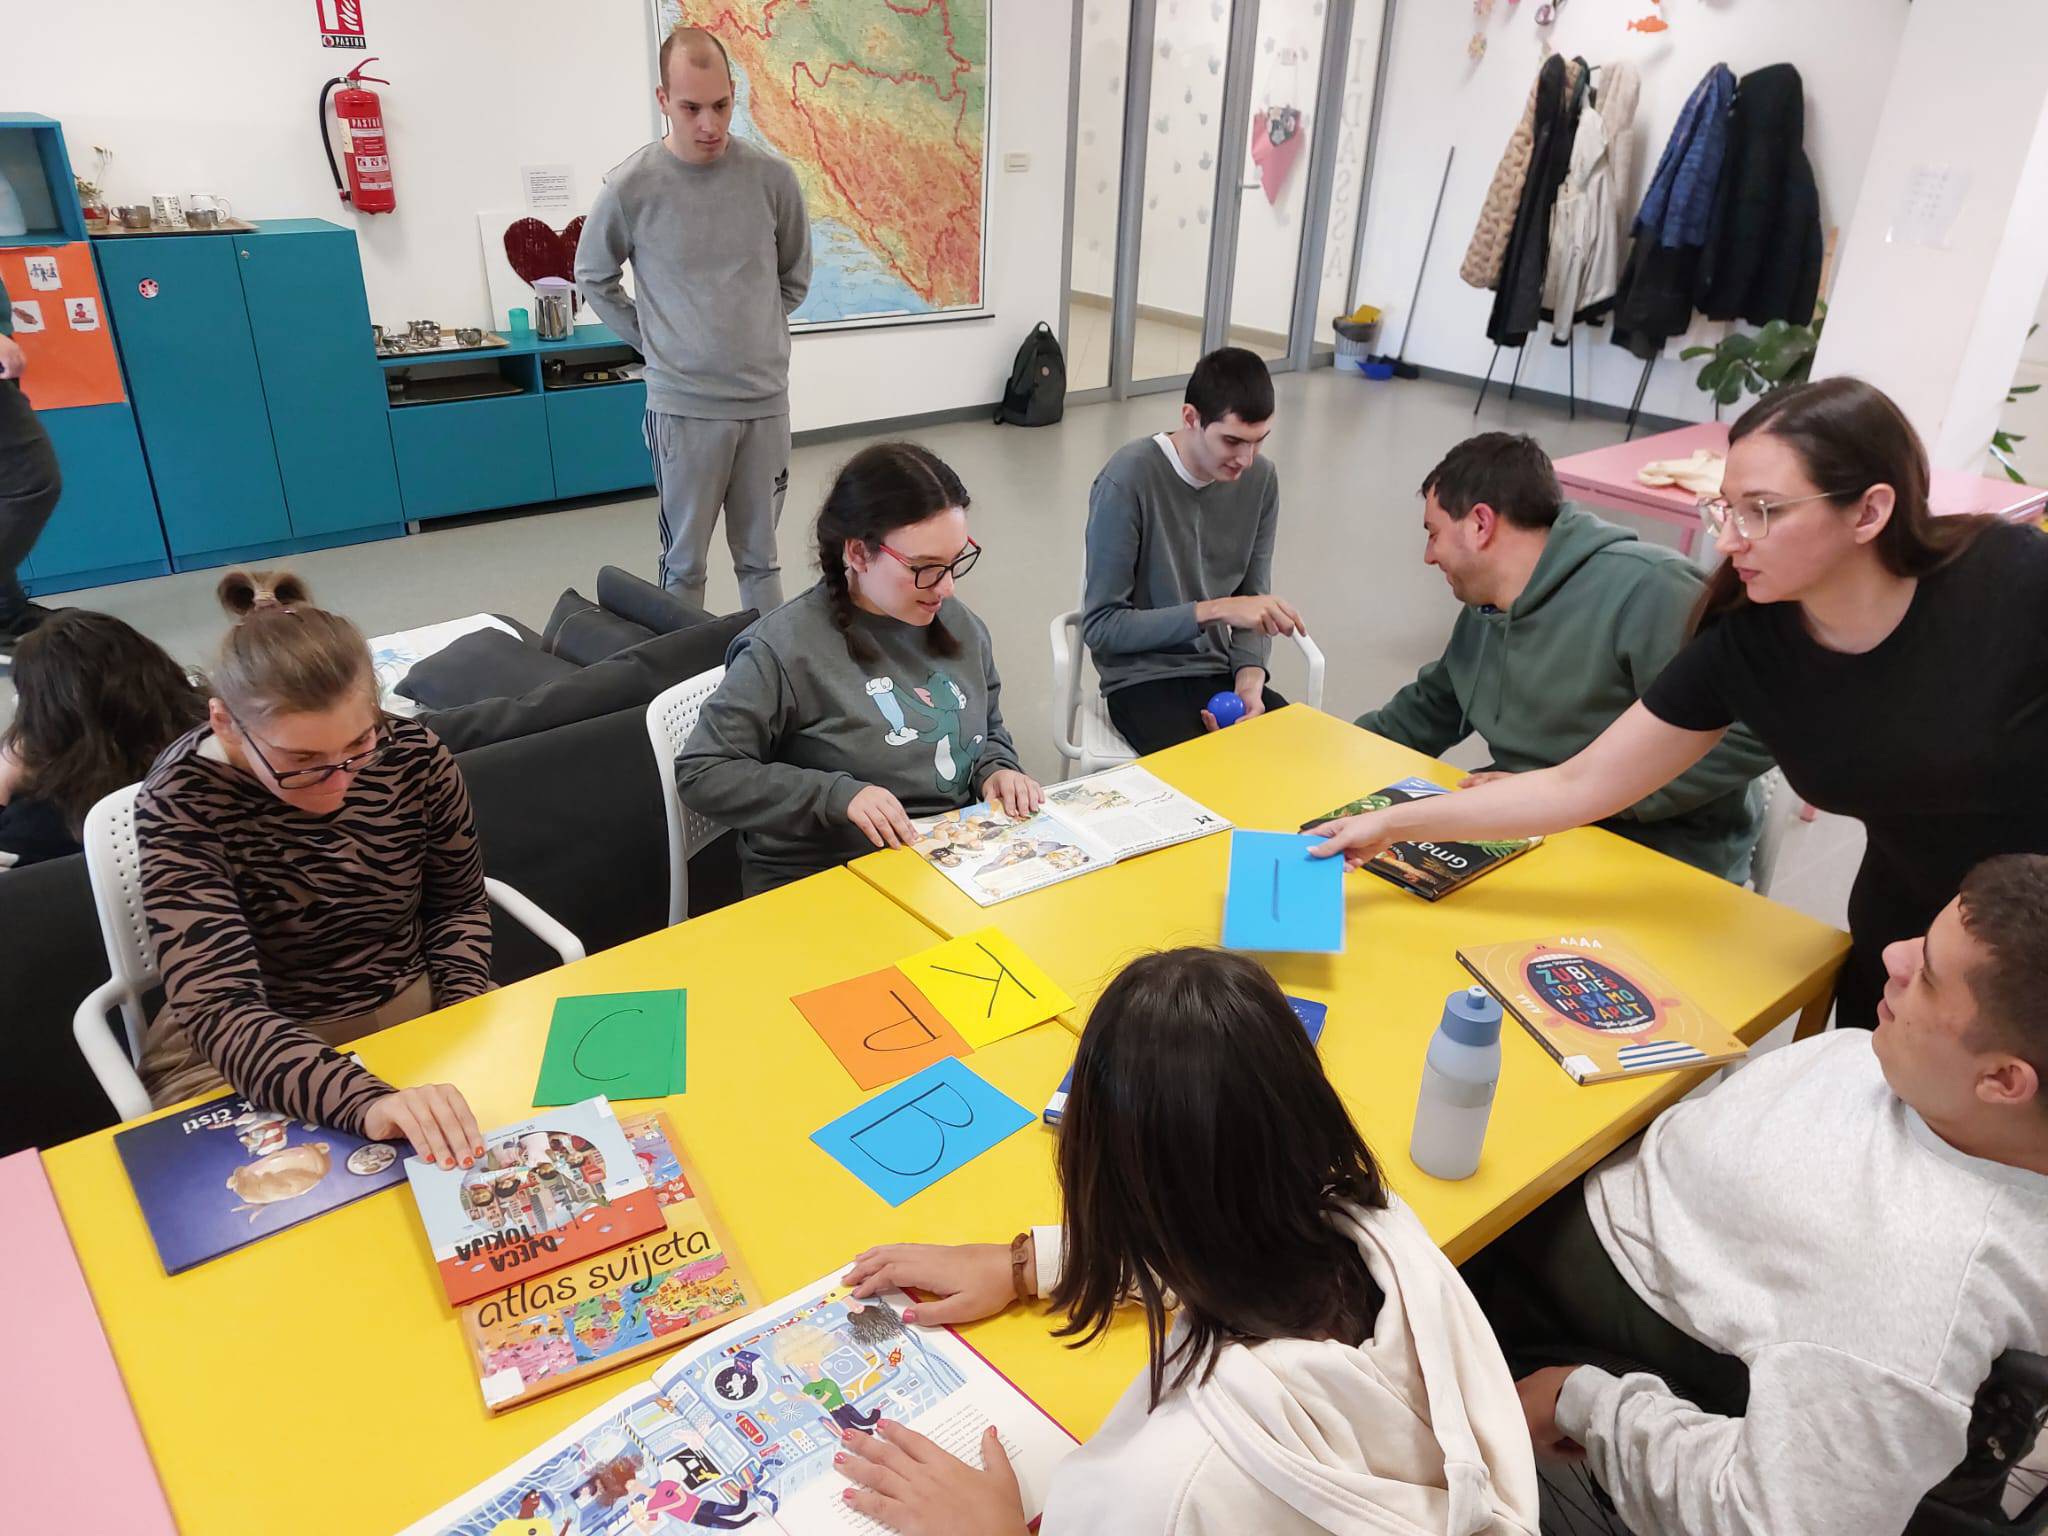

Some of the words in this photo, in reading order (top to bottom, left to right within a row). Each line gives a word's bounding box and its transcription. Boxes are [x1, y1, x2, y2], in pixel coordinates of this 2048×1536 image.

[930, 942, 1036, 1018] K
[1556, 998, 1580, 1012] IH
[1581, 989, 1636, 1008] SAMO
[863, 990, 942, 1051] P
[1573, 1002, 1643, 1023] DVAPUT
[573, 1008, 643, 1081] C
[182, 1108, 233, 1135] čisti
[849, 1081, 974, 1176] B
[478, 1276, 577, 1328] atlas
[589, 1230, 711, 1293] svijeta
[489, 1235, 558, 1272] DJECA
